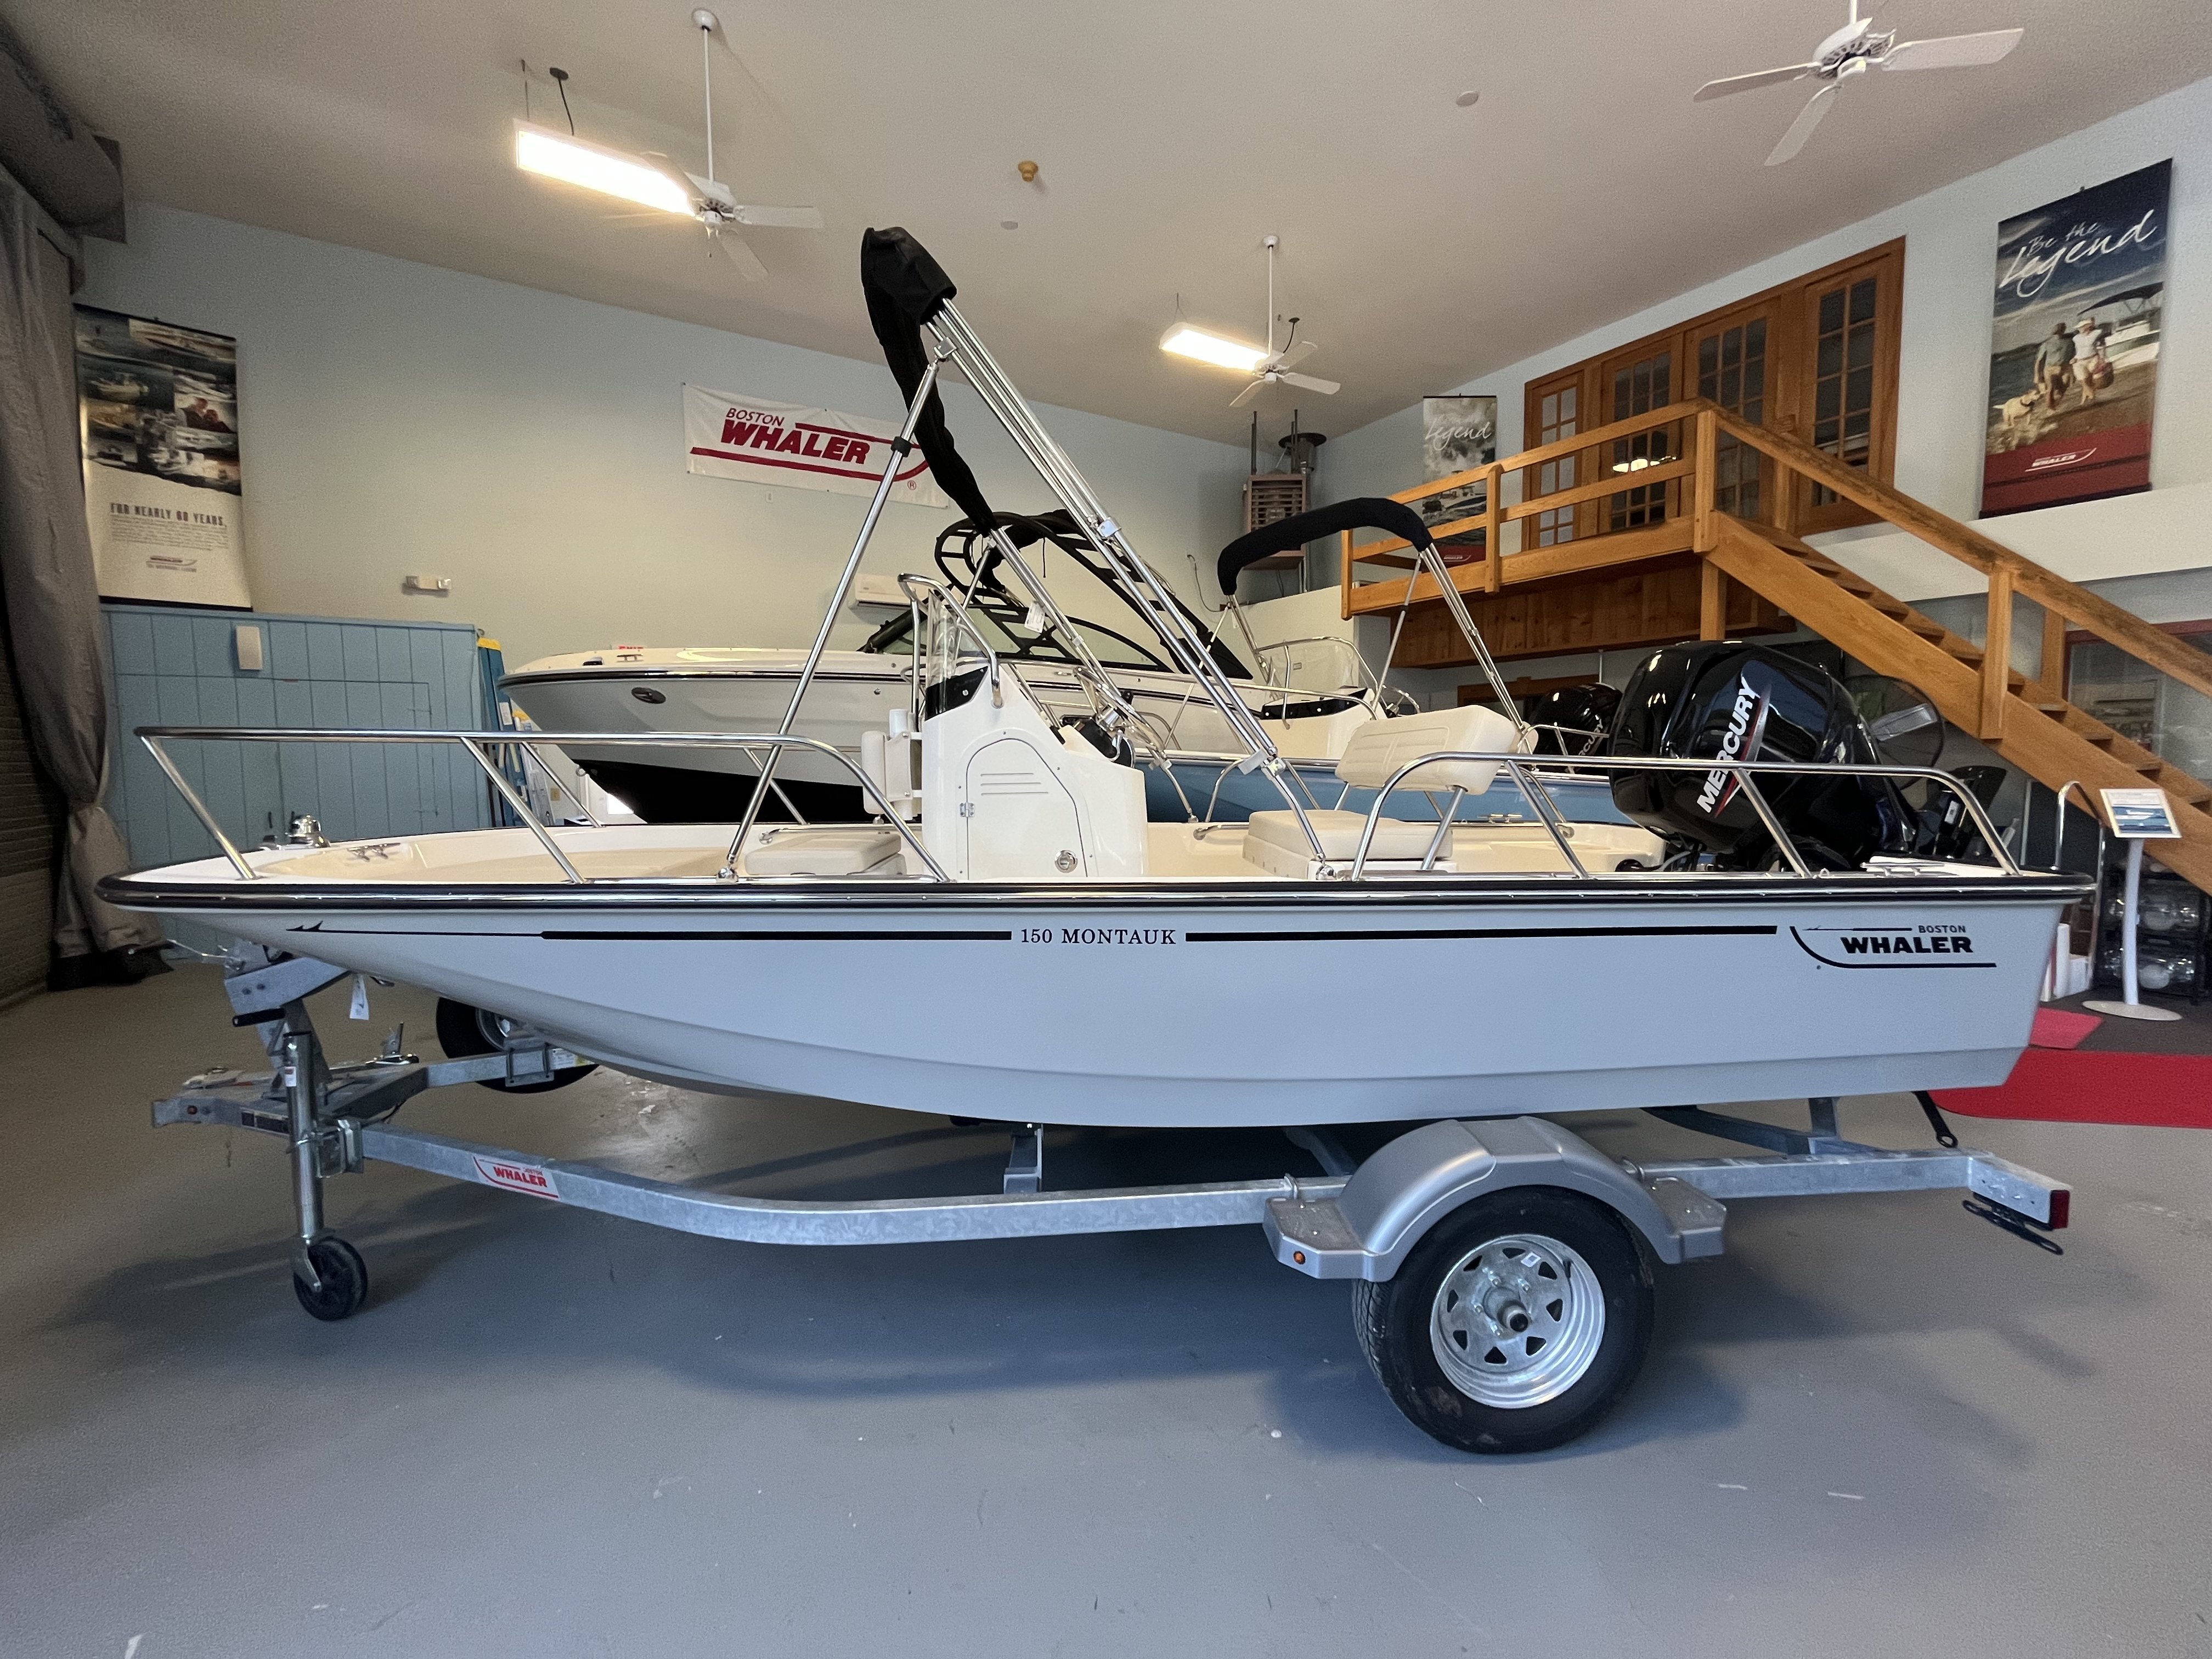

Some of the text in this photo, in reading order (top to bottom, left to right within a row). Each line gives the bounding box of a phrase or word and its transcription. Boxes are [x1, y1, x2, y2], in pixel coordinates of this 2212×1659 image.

[2027, 222, 2101, 258] Be the
[1998, 209, 2158, 298] Legend
[725, 407, 785, 427] BOSTON
[720, 419, 871, 465] WHALER
[1425, 419, 1492, 451] Legend
[111, 503, 129, 515] FOR
[135, 505, 172, 520] NEARLY
[1021, 928, 1176, 944] 150 MONTAUK
[1918, 925, 1966, 933] BOSTON
[1840, 936, 1974, 953] WHALER
[493, 1166, 548, 1188] WHALER
